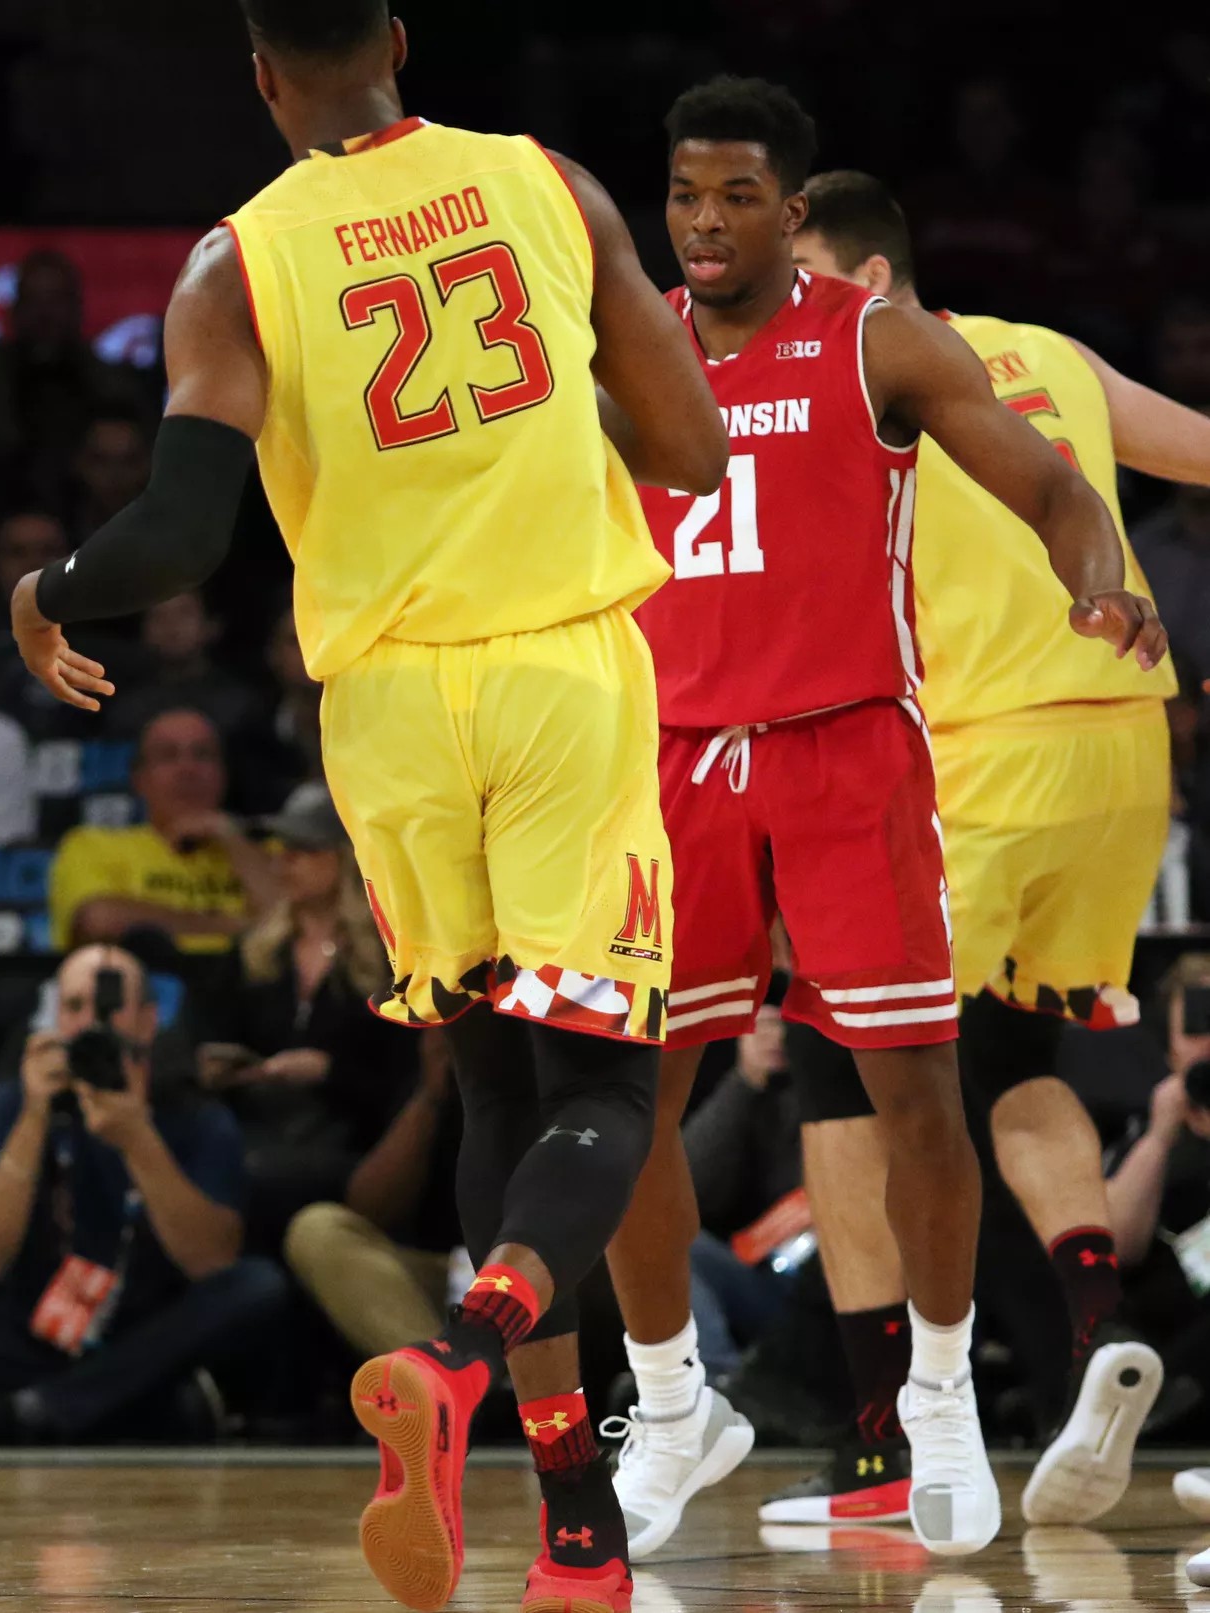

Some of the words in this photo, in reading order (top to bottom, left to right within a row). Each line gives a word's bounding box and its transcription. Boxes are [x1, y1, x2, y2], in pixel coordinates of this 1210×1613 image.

[333, 185, 489, 266] FERNANDO
[338, 240, 555, 452] 23
[668, 454, 765, 580] 21
